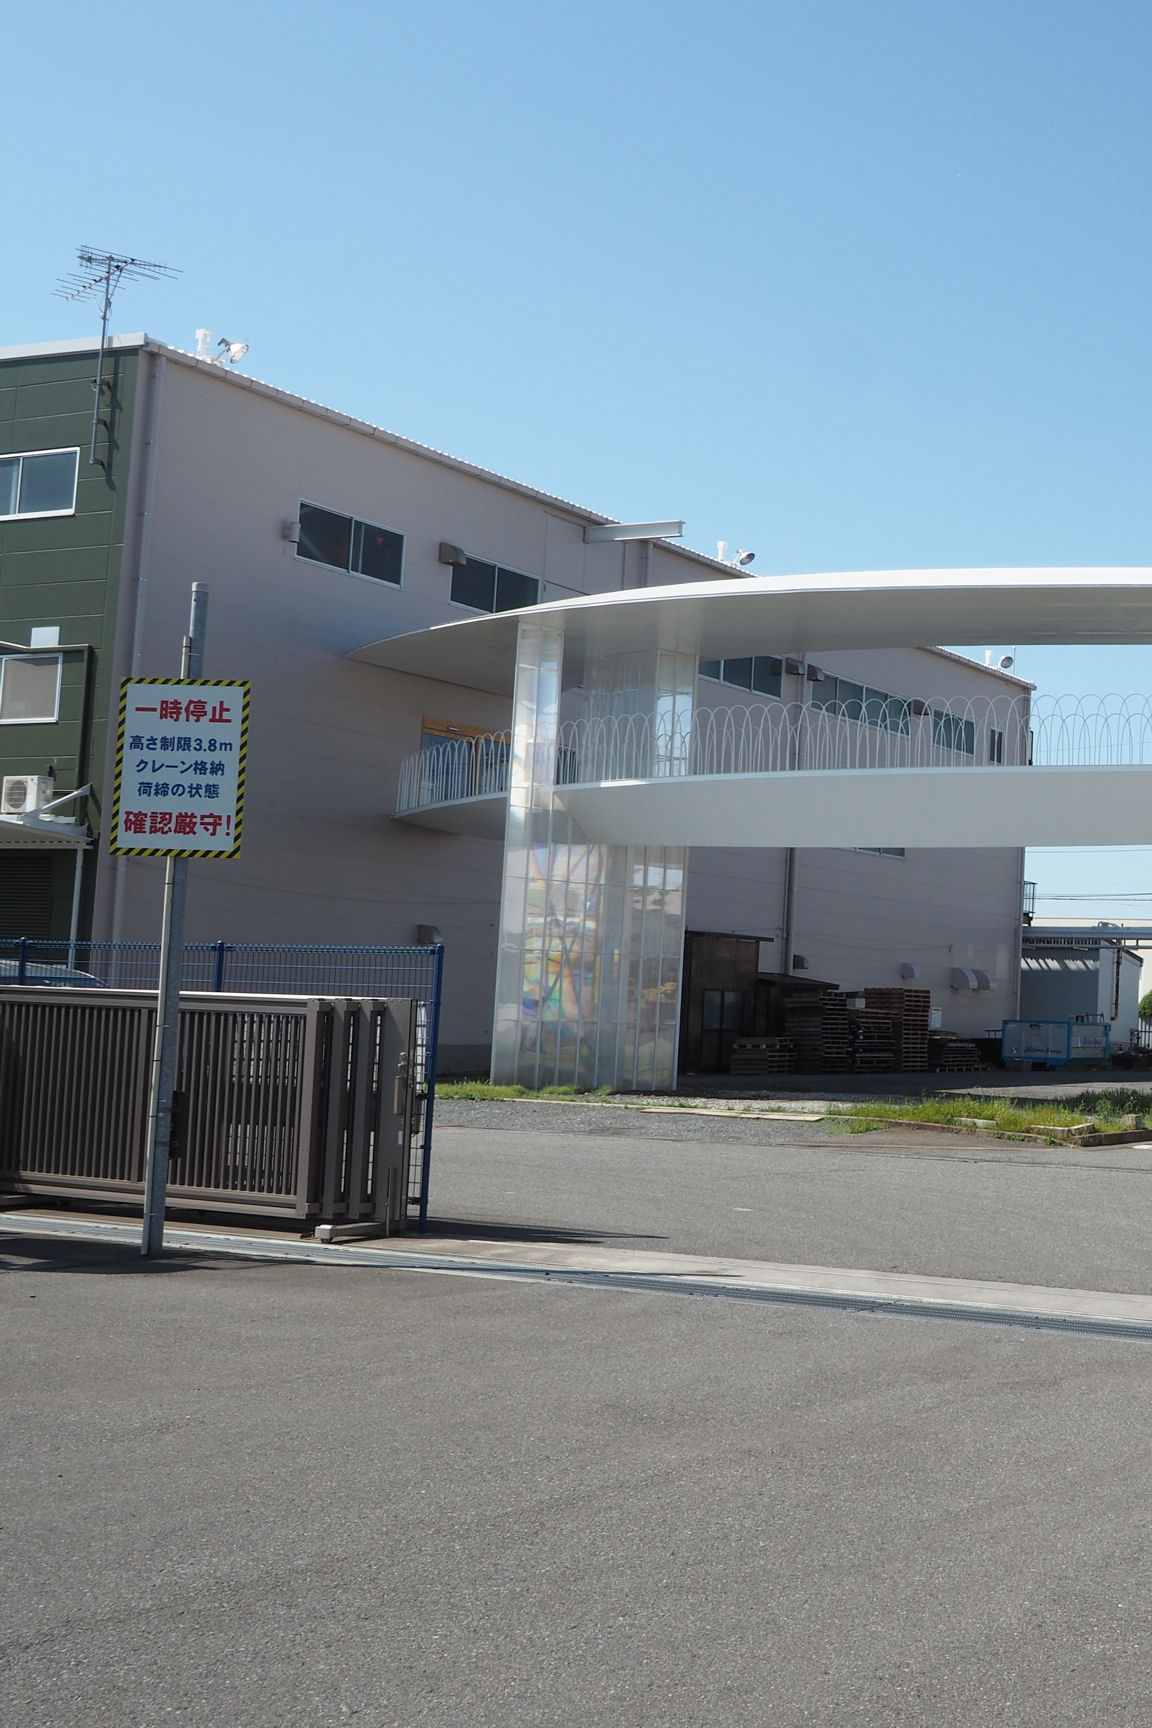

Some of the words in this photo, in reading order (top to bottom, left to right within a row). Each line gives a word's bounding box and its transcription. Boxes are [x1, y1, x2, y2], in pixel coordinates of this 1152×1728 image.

[135, 699, 232, 723] 一時停止
[129, 735, 233, 752] 高さ制限3.8m
[135, 759, 225, 776] クレーン格納
[137, 781, 220, 799] 荷締の状態
[123, 810, 231, 836] 確認厳守!
